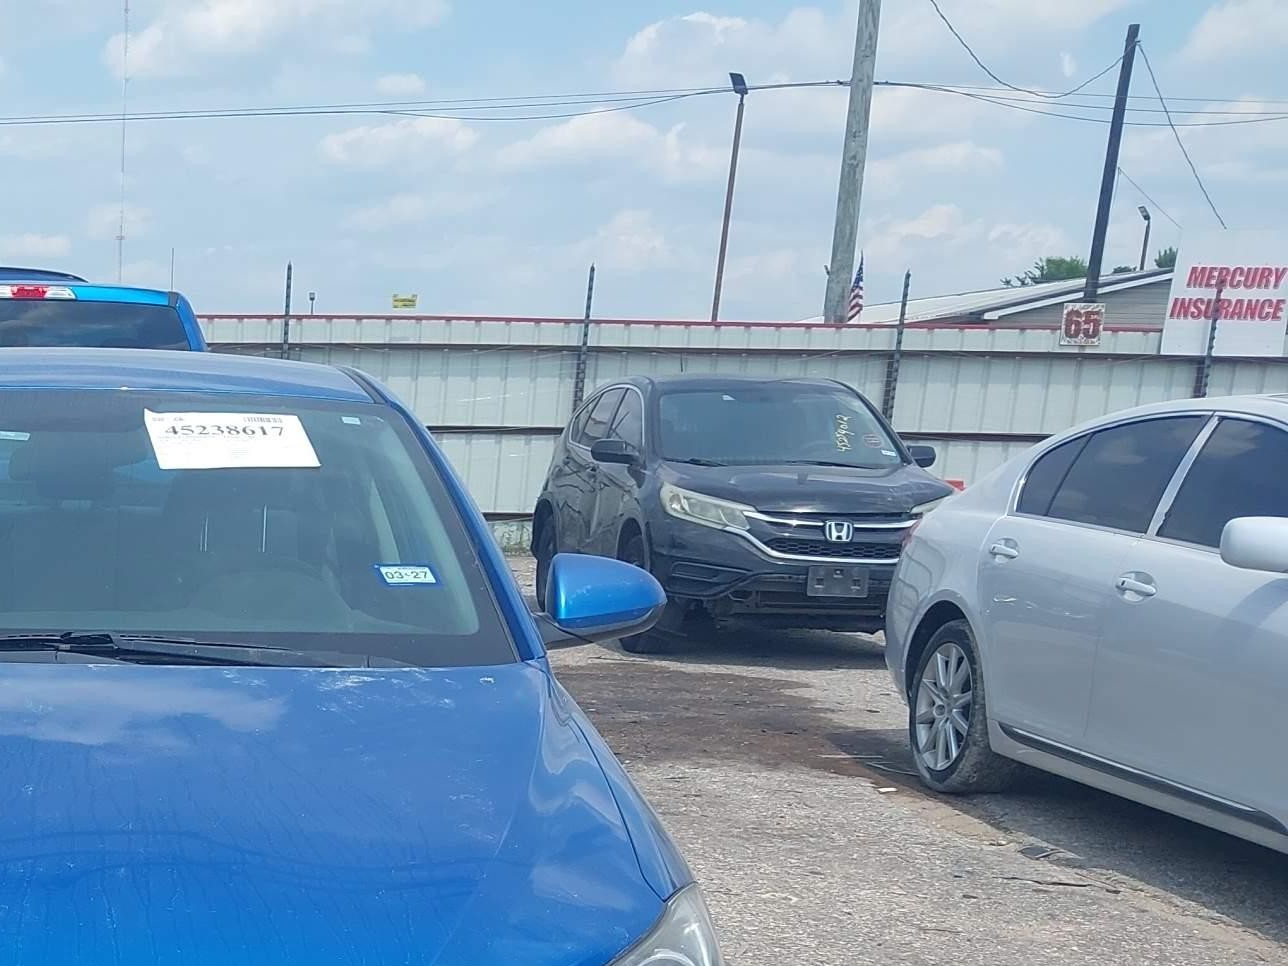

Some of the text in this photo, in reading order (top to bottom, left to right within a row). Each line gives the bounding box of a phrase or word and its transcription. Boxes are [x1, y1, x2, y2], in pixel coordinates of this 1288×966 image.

[1186, 266, 1288, 290] MERCURY
[1169, 297, 1287, 321] INSURANCE
[1064, 308, 1102, 339] 65
[164, 424, 285, 437] 45238617
